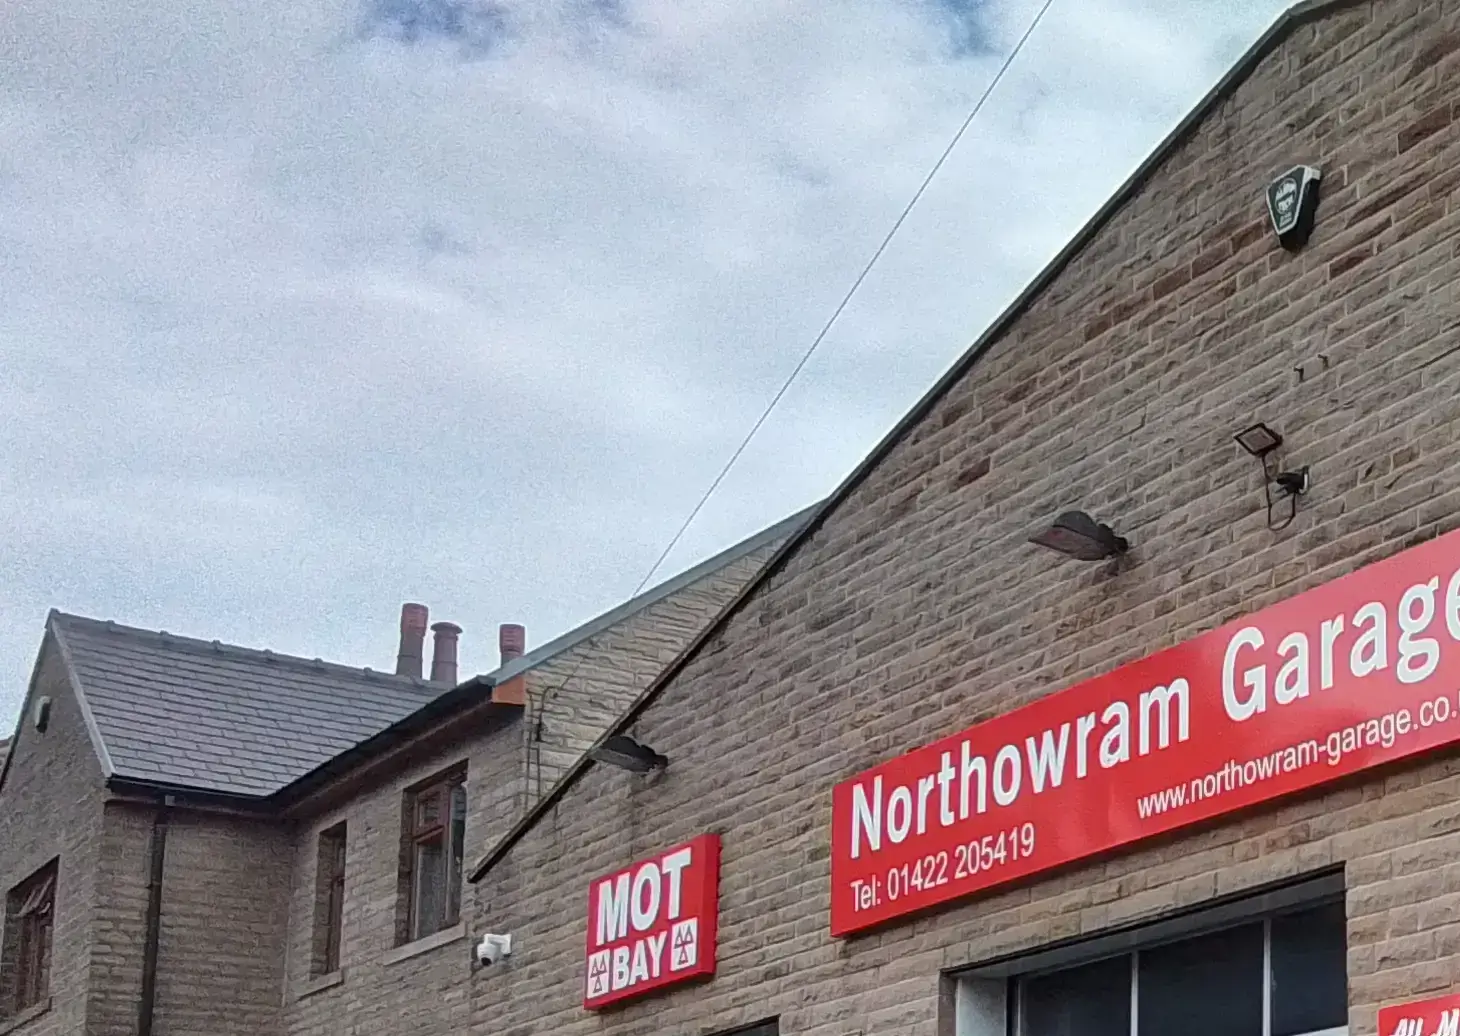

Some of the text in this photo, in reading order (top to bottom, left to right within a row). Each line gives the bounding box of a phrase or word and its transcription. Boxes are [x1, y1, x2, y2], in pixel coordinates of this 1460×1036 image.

[850, 676, 1190, 859] Northowram
[596, 847, 692, 946] MOT
[850, 822, 1035, 912] Tel: 01422 205419
[612, 930, 667, 990] BAY
